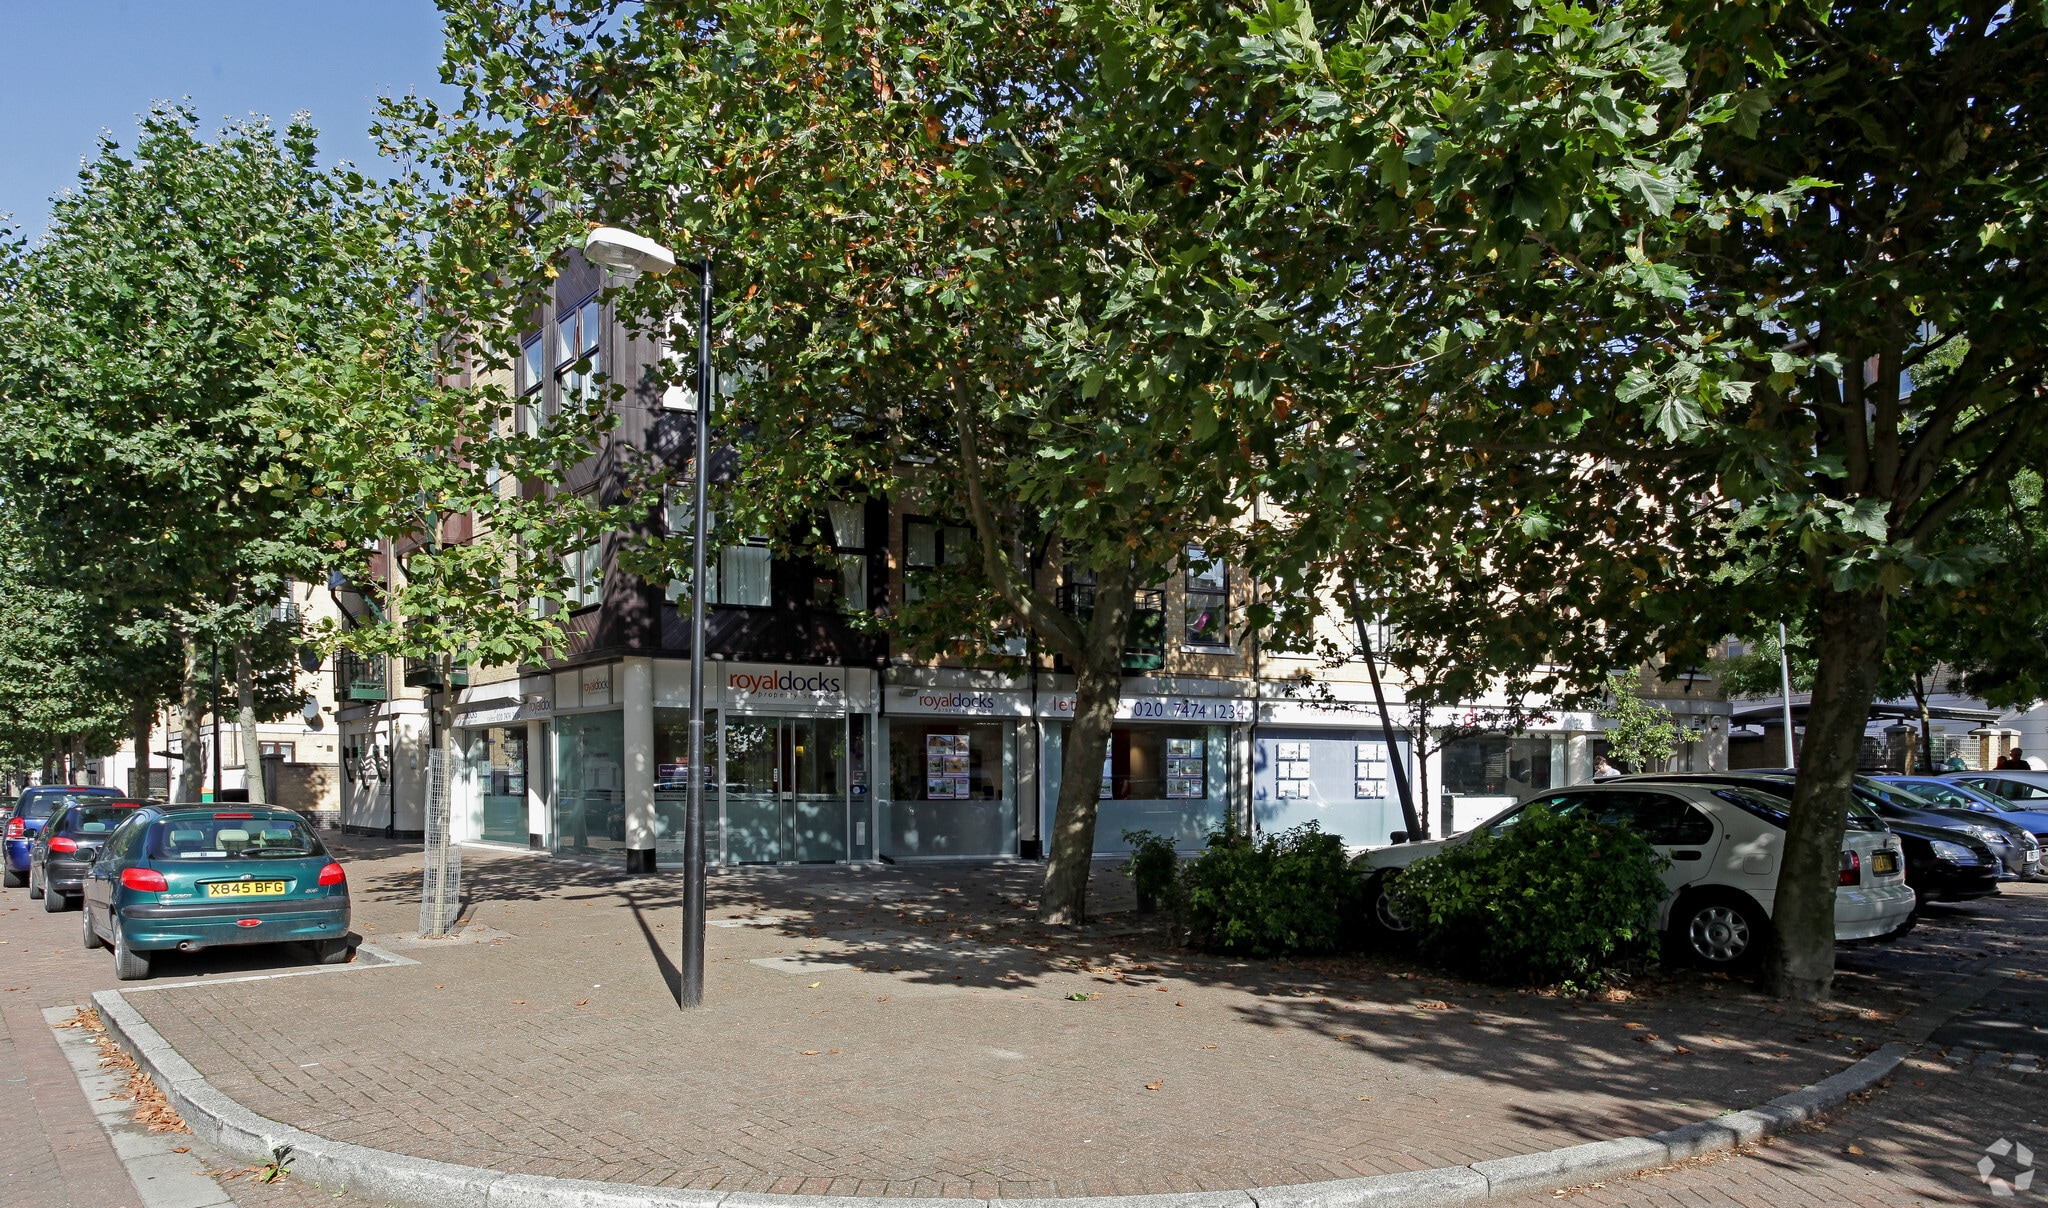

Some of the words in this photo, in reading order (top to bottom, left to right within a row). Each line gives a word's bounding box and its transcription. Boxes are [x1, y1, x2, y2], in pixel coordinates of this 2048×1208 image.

[729, 670, 840, 694] royaldocks
[919, 692, 994, 710] royaldocks
[1134, 701, 1163, 717] 020
[1173, 702, 1207, 719] 7474
[1213, 704, 1245, 719] 1234
[211, 883, 251, 895] X845
[255, 882, 283, 893] BFG
